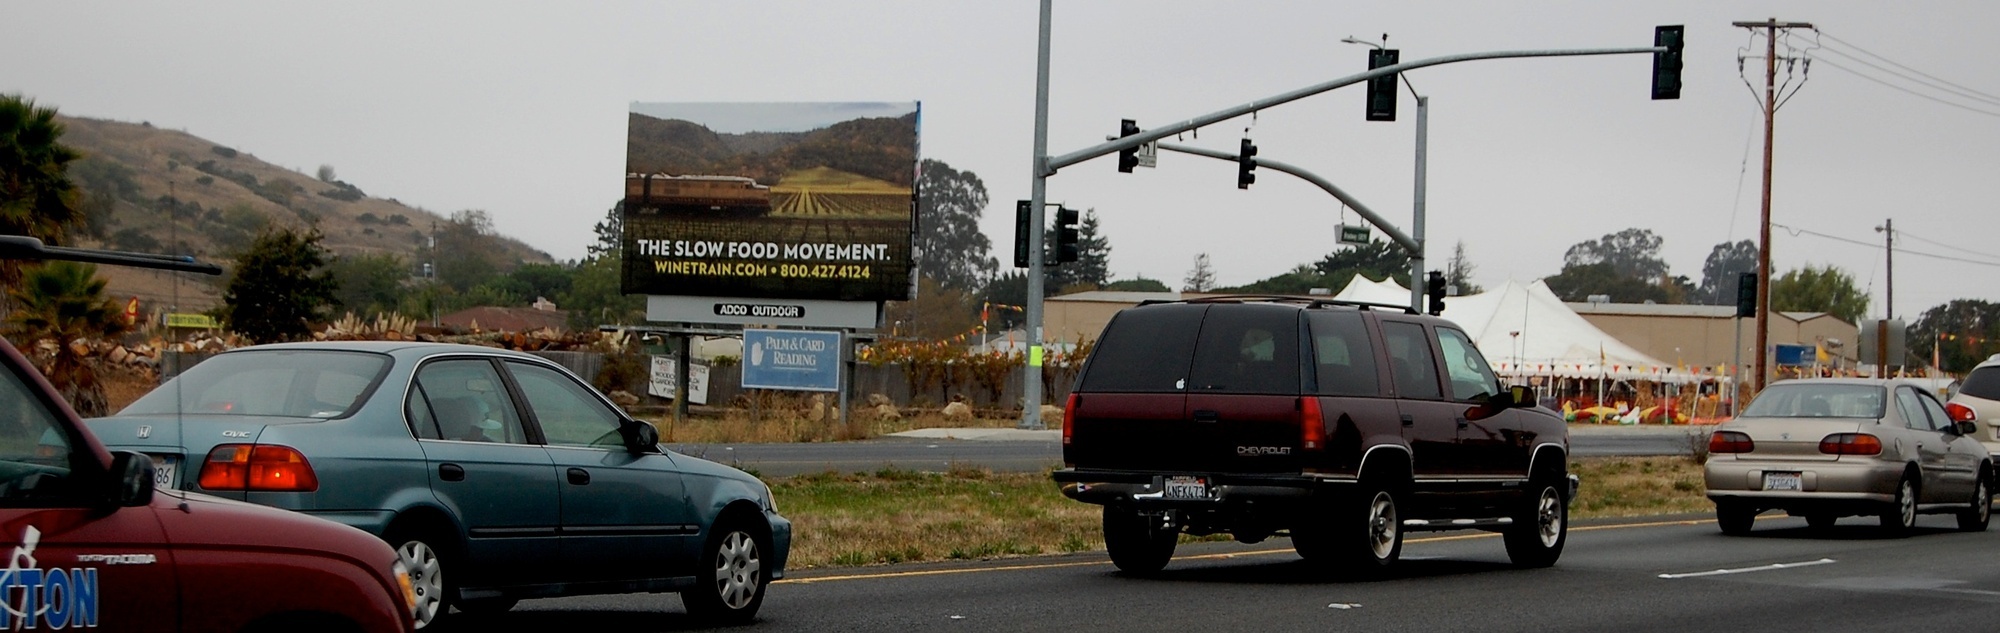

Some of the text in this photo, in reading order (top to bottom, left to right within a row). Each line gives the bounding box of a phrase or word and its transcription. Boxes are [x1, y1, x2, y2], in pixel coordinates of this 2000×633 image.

[637, 239, 890, 260] THE SLOW FOOD MOVEMENT.
[655, 260, 870, 278] WINETRAIN.COM 800.427.4124
[720, 304, 799, 317] ADCO OUTDOOR
[765, 336, 826, 352] PALM & CARD
[773, 351, 817, 366] READING
[1237, 446, 1291, 455] CHEVROLET
